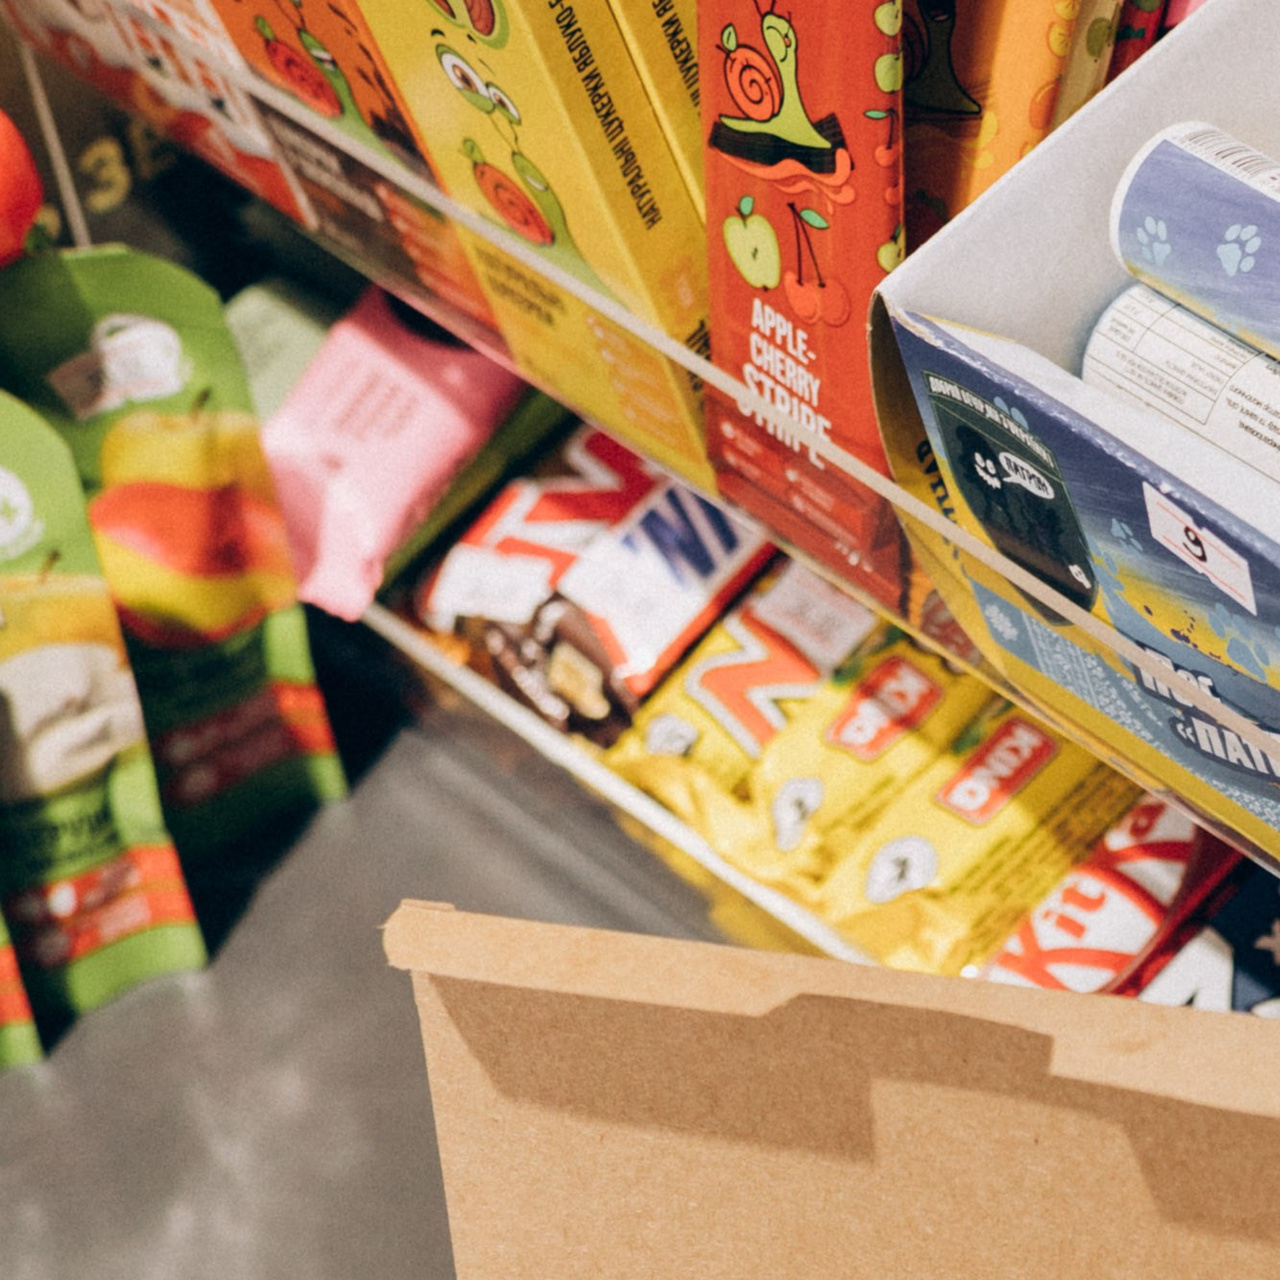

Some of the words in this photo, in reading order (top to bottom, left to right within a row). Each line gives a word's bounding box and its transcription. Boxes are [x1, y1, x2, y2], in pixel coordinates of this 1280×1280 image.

[547, 0, 594, 72] ЯБЛУКО-
[581, 66, 626, 148] ЦУКЕРКИ
[751, 298, 817, 364] APPLE-
[749, 332, 821, 407] CHERRY
[736, 363, 832, 469] STRIPE
[1004, 456, 1049, 495] ПАТРОН
